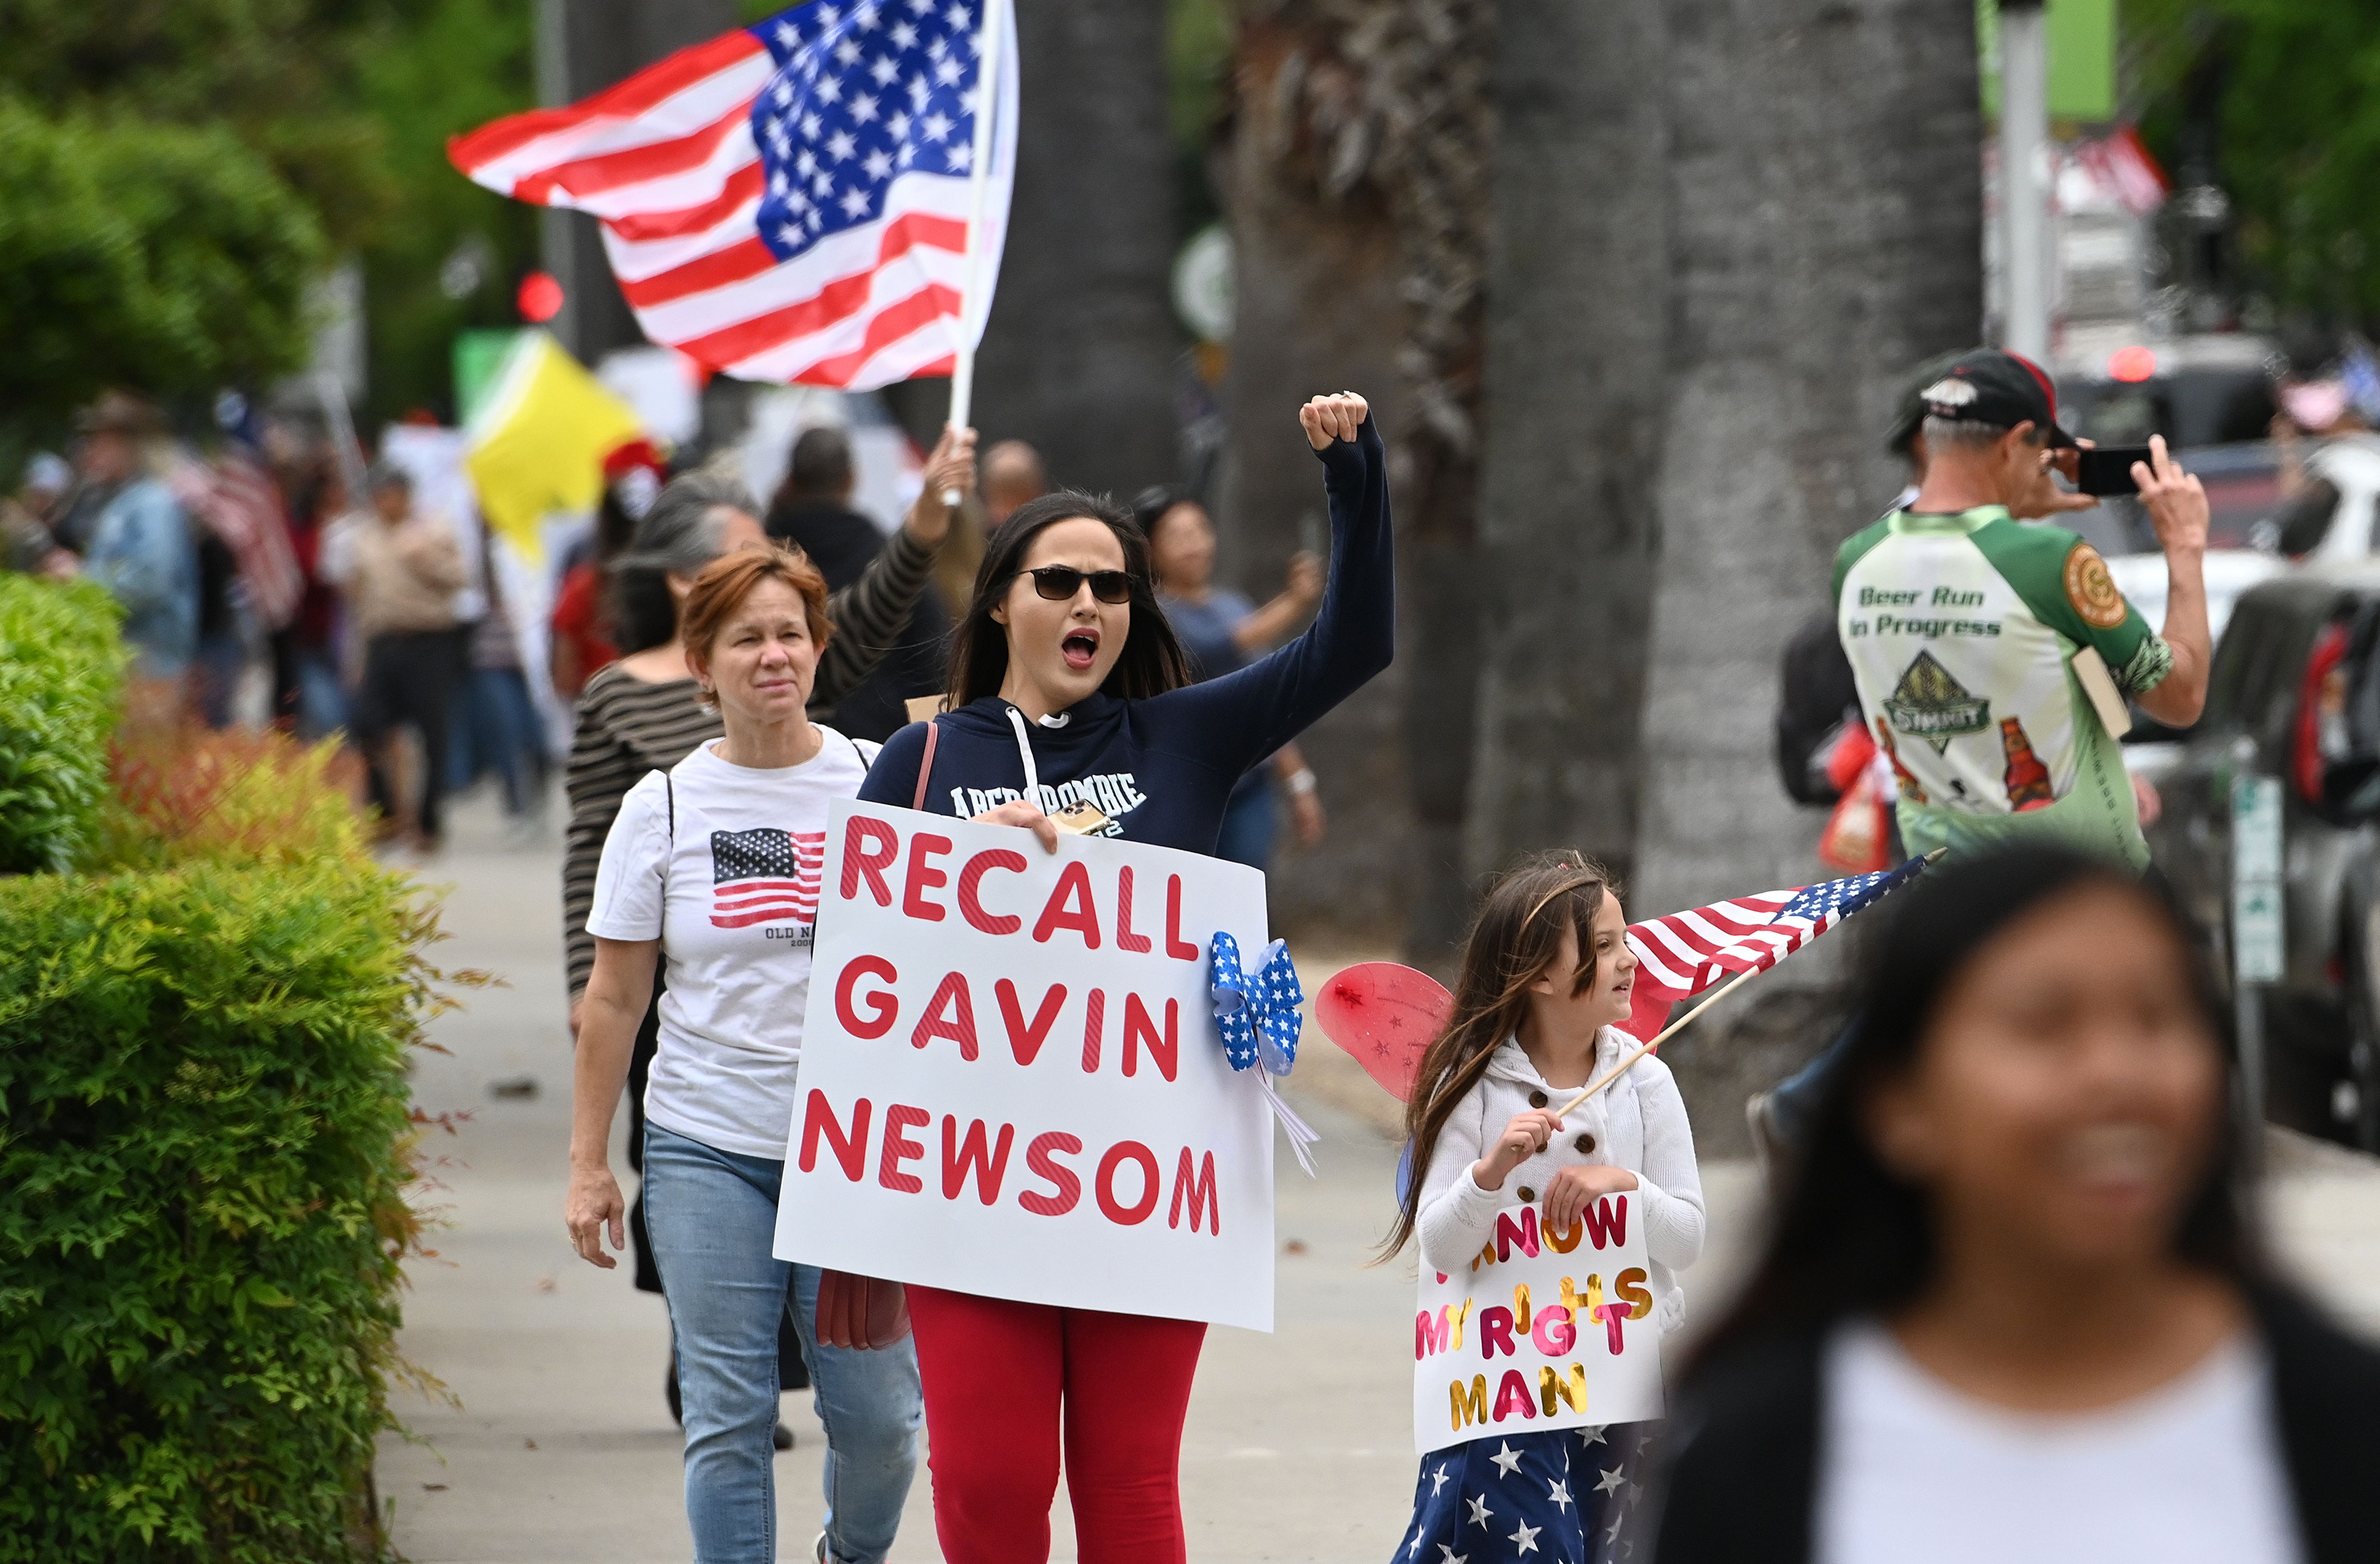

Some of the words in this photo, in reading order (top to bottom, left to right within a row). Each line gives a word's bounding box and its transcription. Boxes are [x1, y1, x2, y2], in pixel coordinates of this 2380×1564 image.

[1859, 585, 1921, 606] Beer
[1931, 586, 1984, 606] Run
[1876, 614, 2002, 639] Progress
[840, 814, 1199, 962] RECALL
[766, 928, 793, 939] OLD
[834, 954, 1178, 1083] GAVIN
[798, 1088, 1220, 1237] NEWSOM
[1472, 1195, 1627, 1272] NOW
[1415, 1297, 1473, 1361] MY
[1449, 1361, 1587, 1431] MAN
